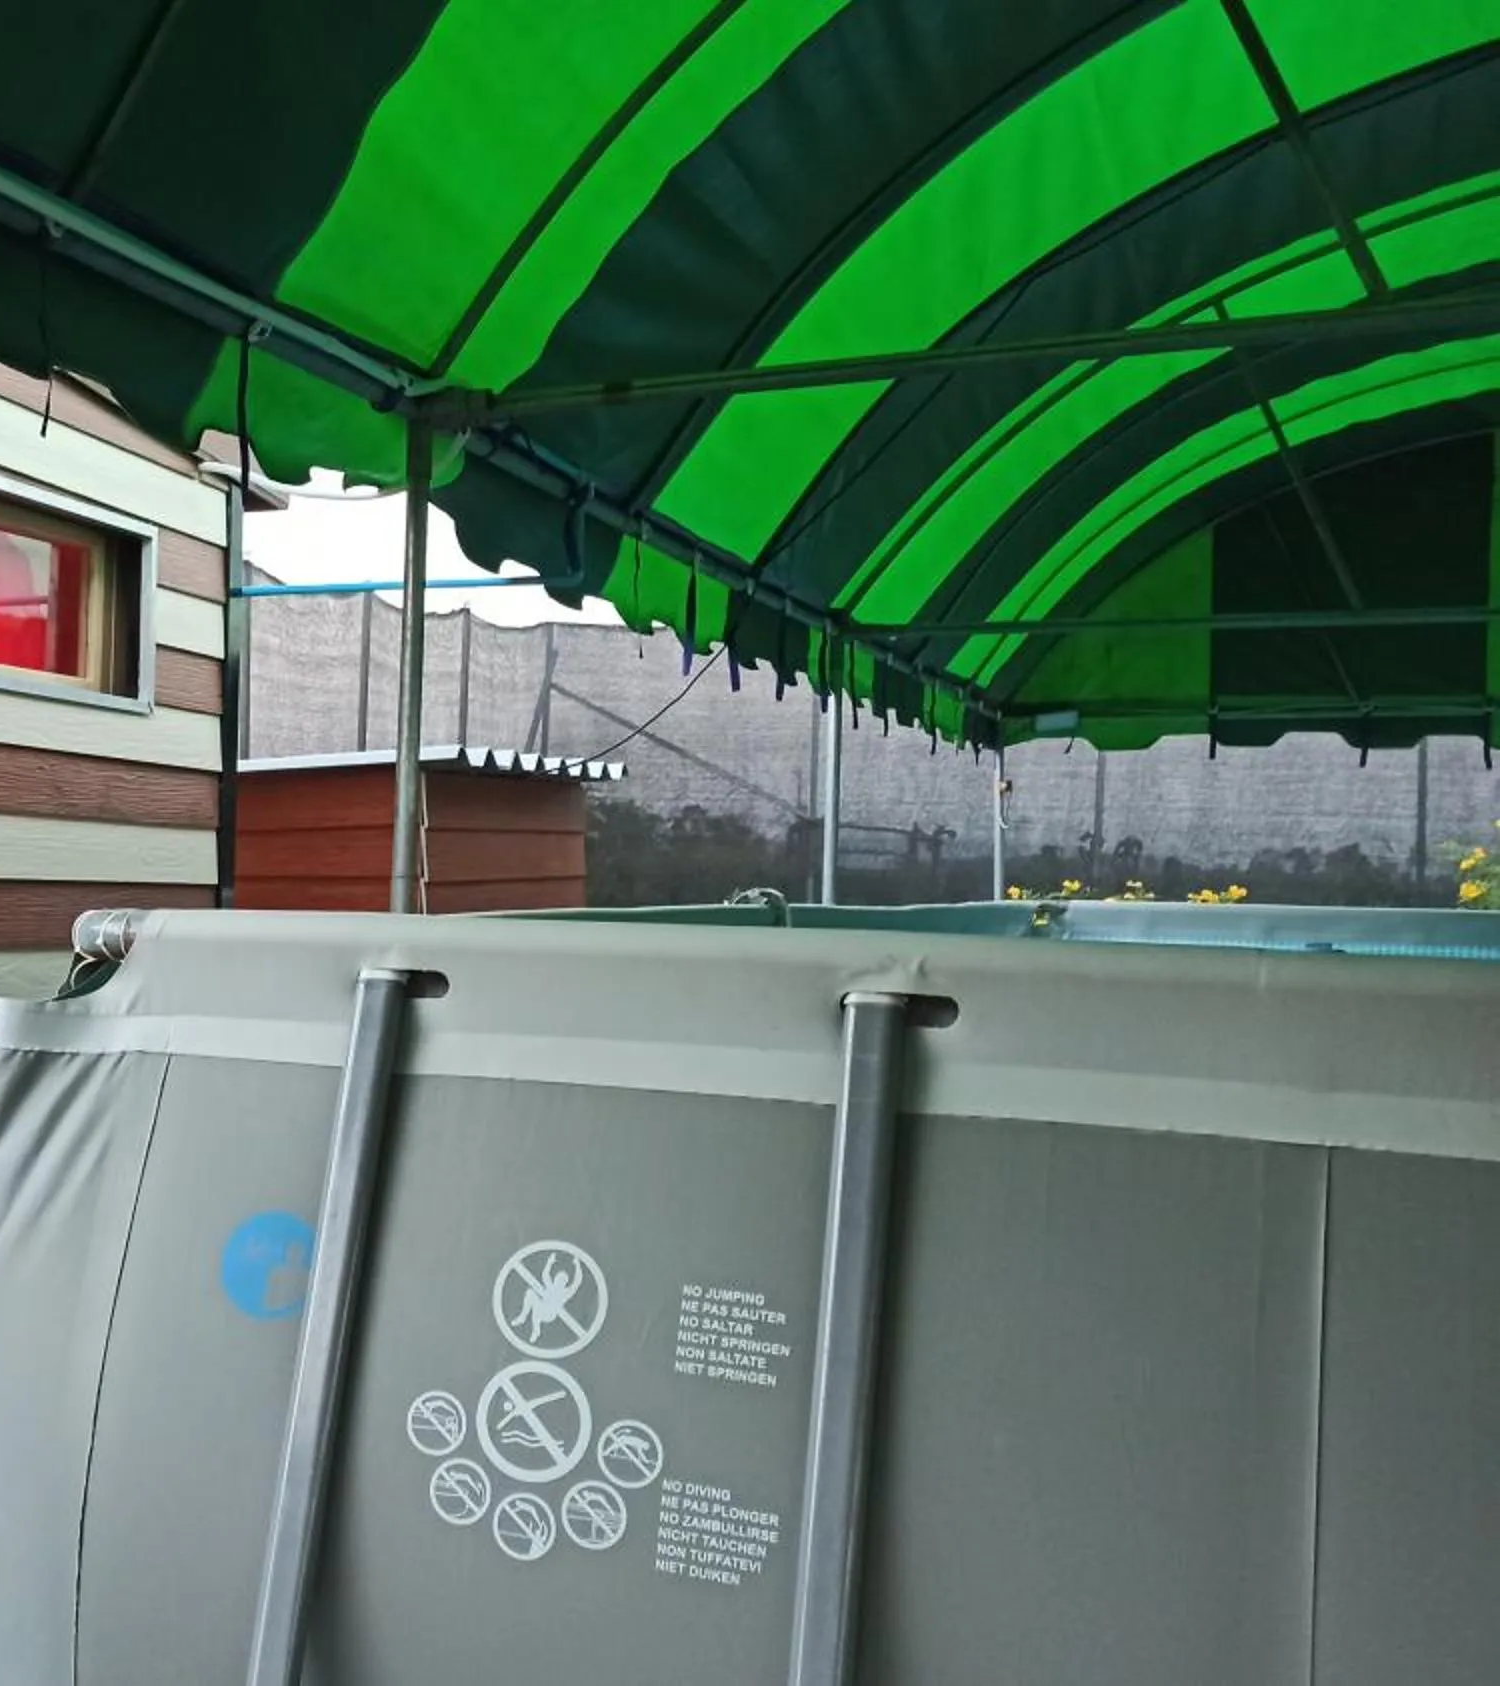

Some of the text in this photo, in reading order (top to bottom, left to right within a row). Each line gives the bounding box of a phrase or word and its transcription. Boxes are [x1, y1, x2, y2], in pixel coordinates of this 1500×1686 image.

[683, 1285, 765, 1305] NO JUMPING
[681, 1300, 786, 1324] NE PAS SAUTER
[679, 1315, 753, 1335] NO SALTAR
[678, 1330, 791, 1356] NICHT SPRINGEN
[676, 1346, 767, 1368] NON SALTATE
[675, 1360, 776, 1387] NIET SPRINGEN
[662, 1479, 731, 1500] NO DIVING
[661, 1496, 779, 1526] NE PAS PLONGER
[660, 1512, 779, 1543] NO ZAMBULLIRSE
[658, 1527, 766, 1557] NICHT TAUCHEN
[657, 1543, 761, 1573] NON TUFFATEVI
[656, 1560, 740, 1585] NIET DUIKEN
